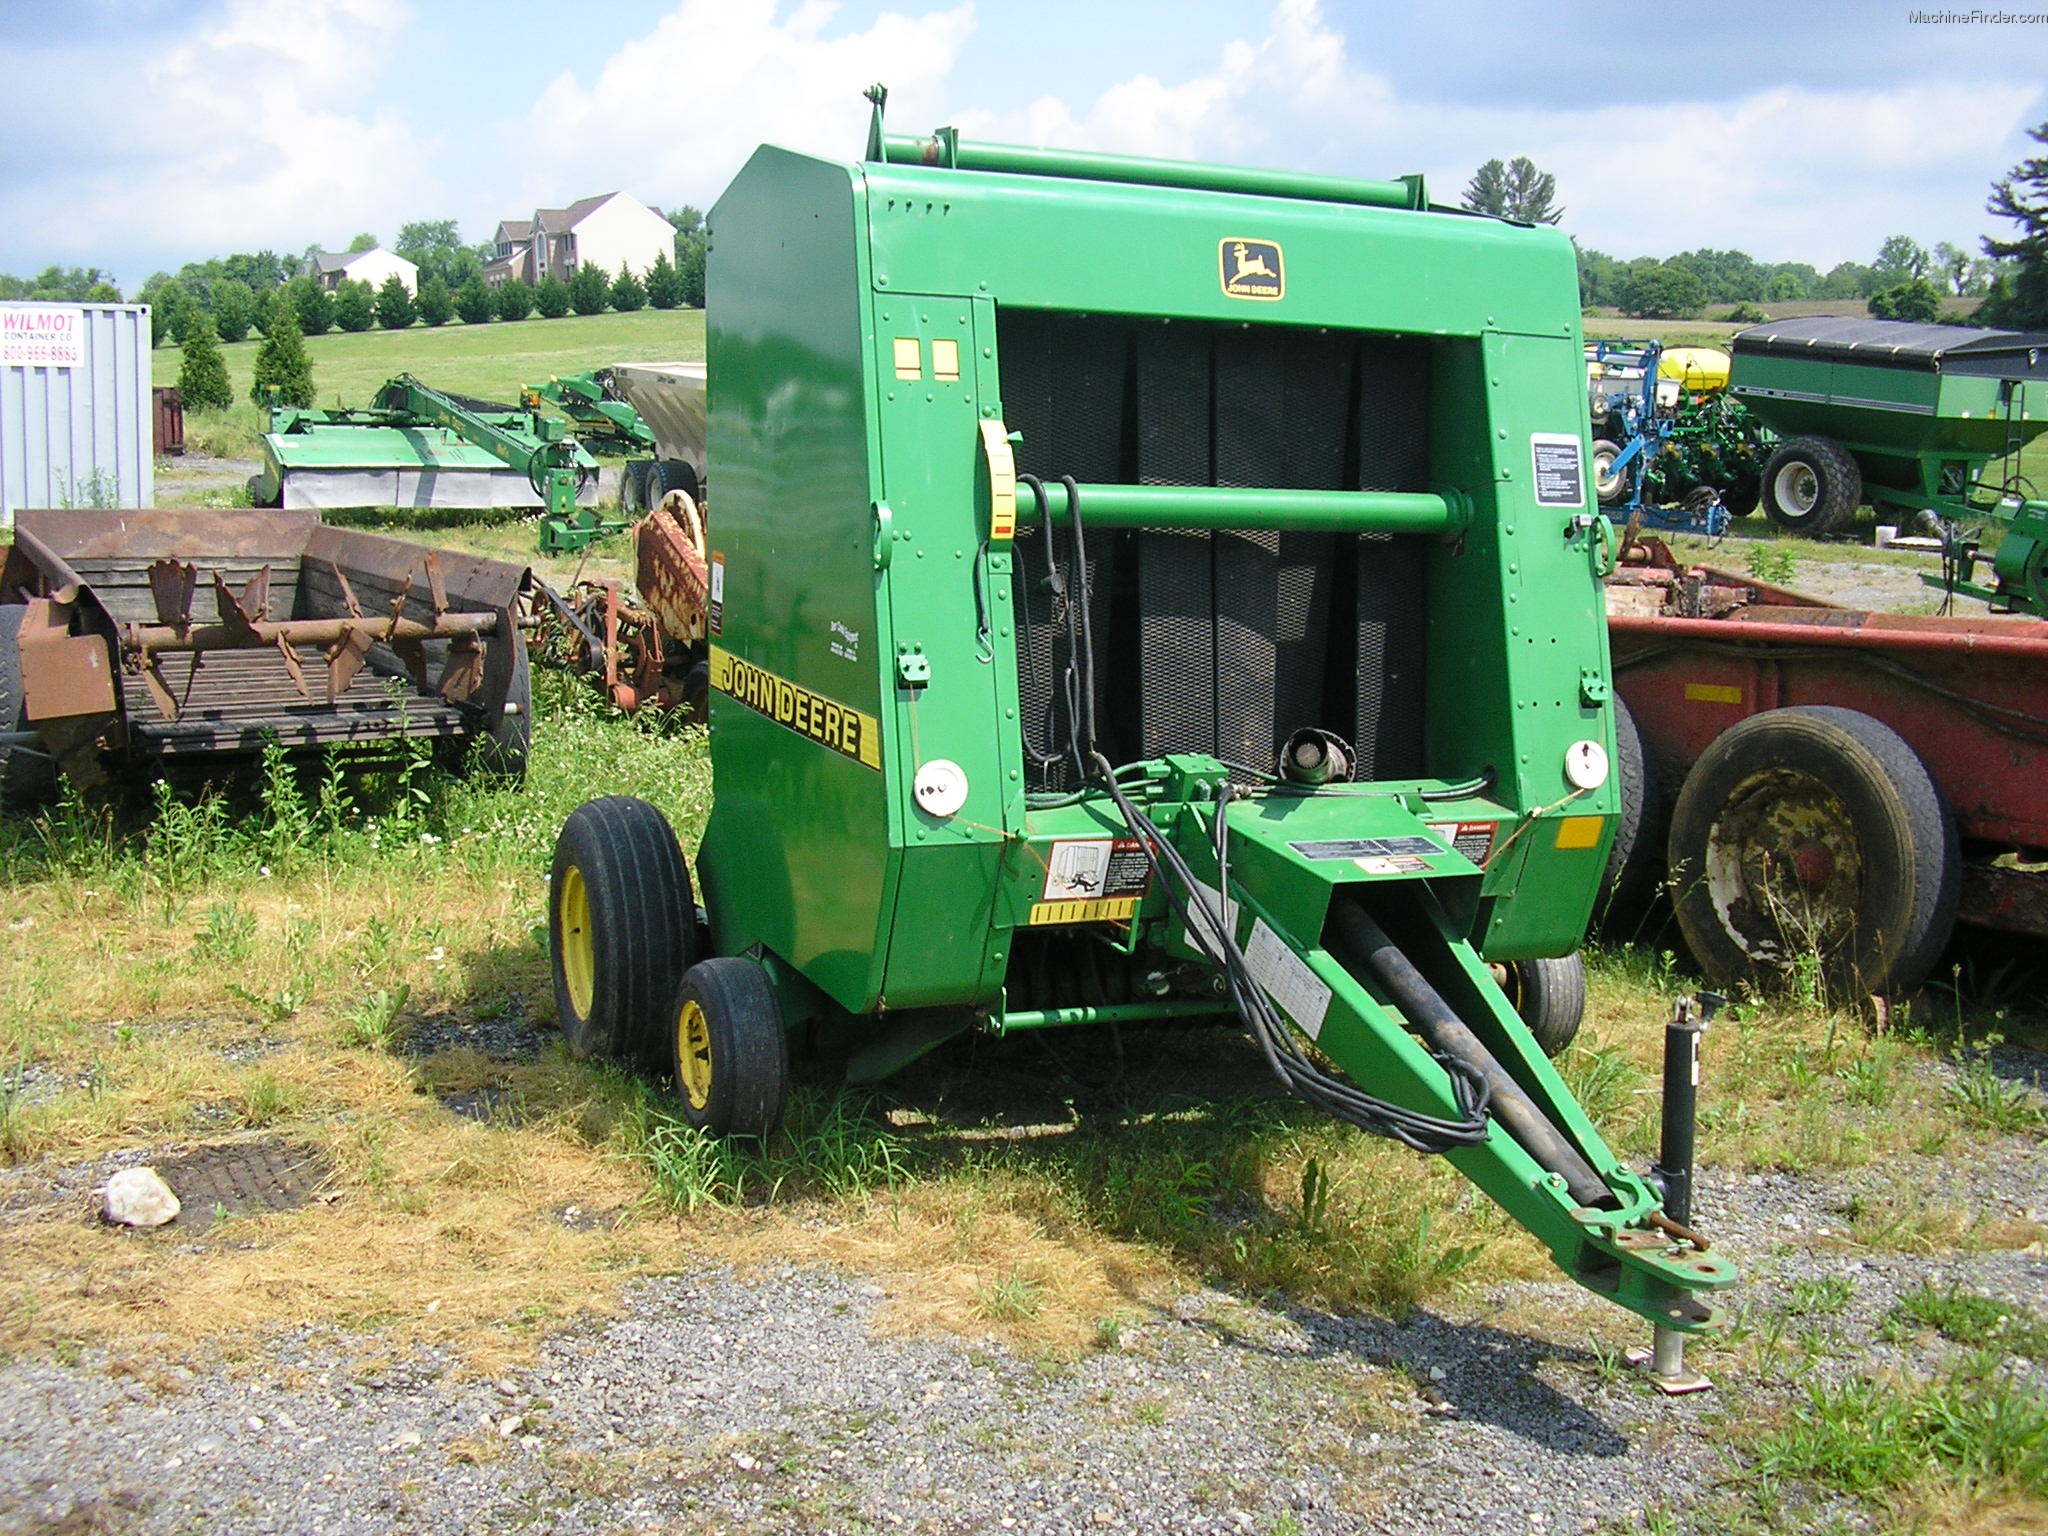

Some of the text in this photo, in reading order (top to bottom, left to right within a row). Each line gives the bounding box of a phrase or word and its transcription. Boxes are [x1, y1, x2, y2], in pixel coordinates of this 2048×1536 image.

[4, 313, 74, 331] WILMOT
[4, 331, 56, 341] CONTAINER
[722, 656, 861, 754] JOHN DEERE
